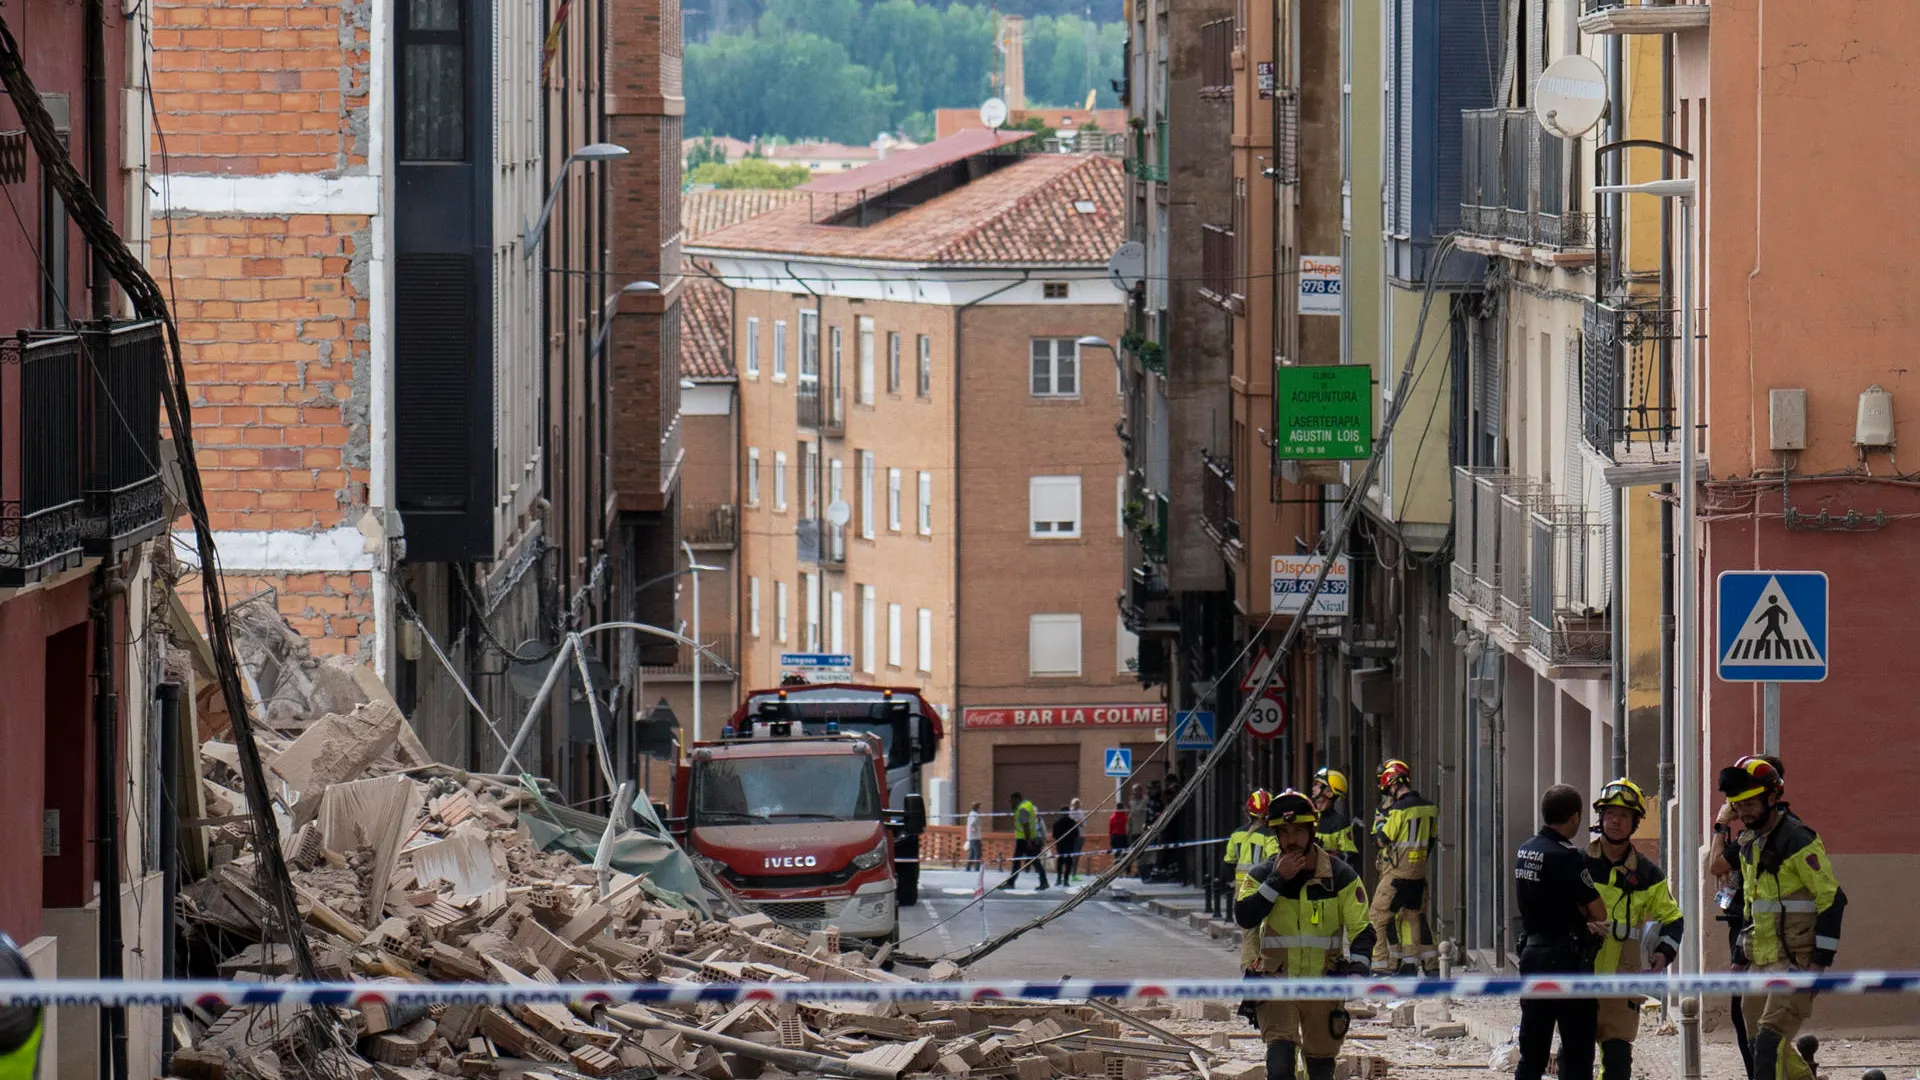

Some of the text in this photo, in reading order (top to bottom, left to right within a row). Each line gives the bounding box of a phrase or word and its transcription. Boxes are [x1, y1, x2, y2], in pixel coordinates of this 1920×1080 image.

[1302, 280, 1325, 293] 978
[1291, 389, 1357, 403] ACUPUNTURA
[1288, 415, 1360, 428] LASERTERAPIA
[1289, 429, 1360, 442] AGUSTIN LOIS
[1331, 582, 1346, 593] 39
[1013, 709, 1053, 725] BAR
[1061, 708, 1085, 724] LA
[1093, 707, 1163, 724] COLME
[1253, 707, 1278, 724] 30
[764, 855, 817, 869] IVECO
